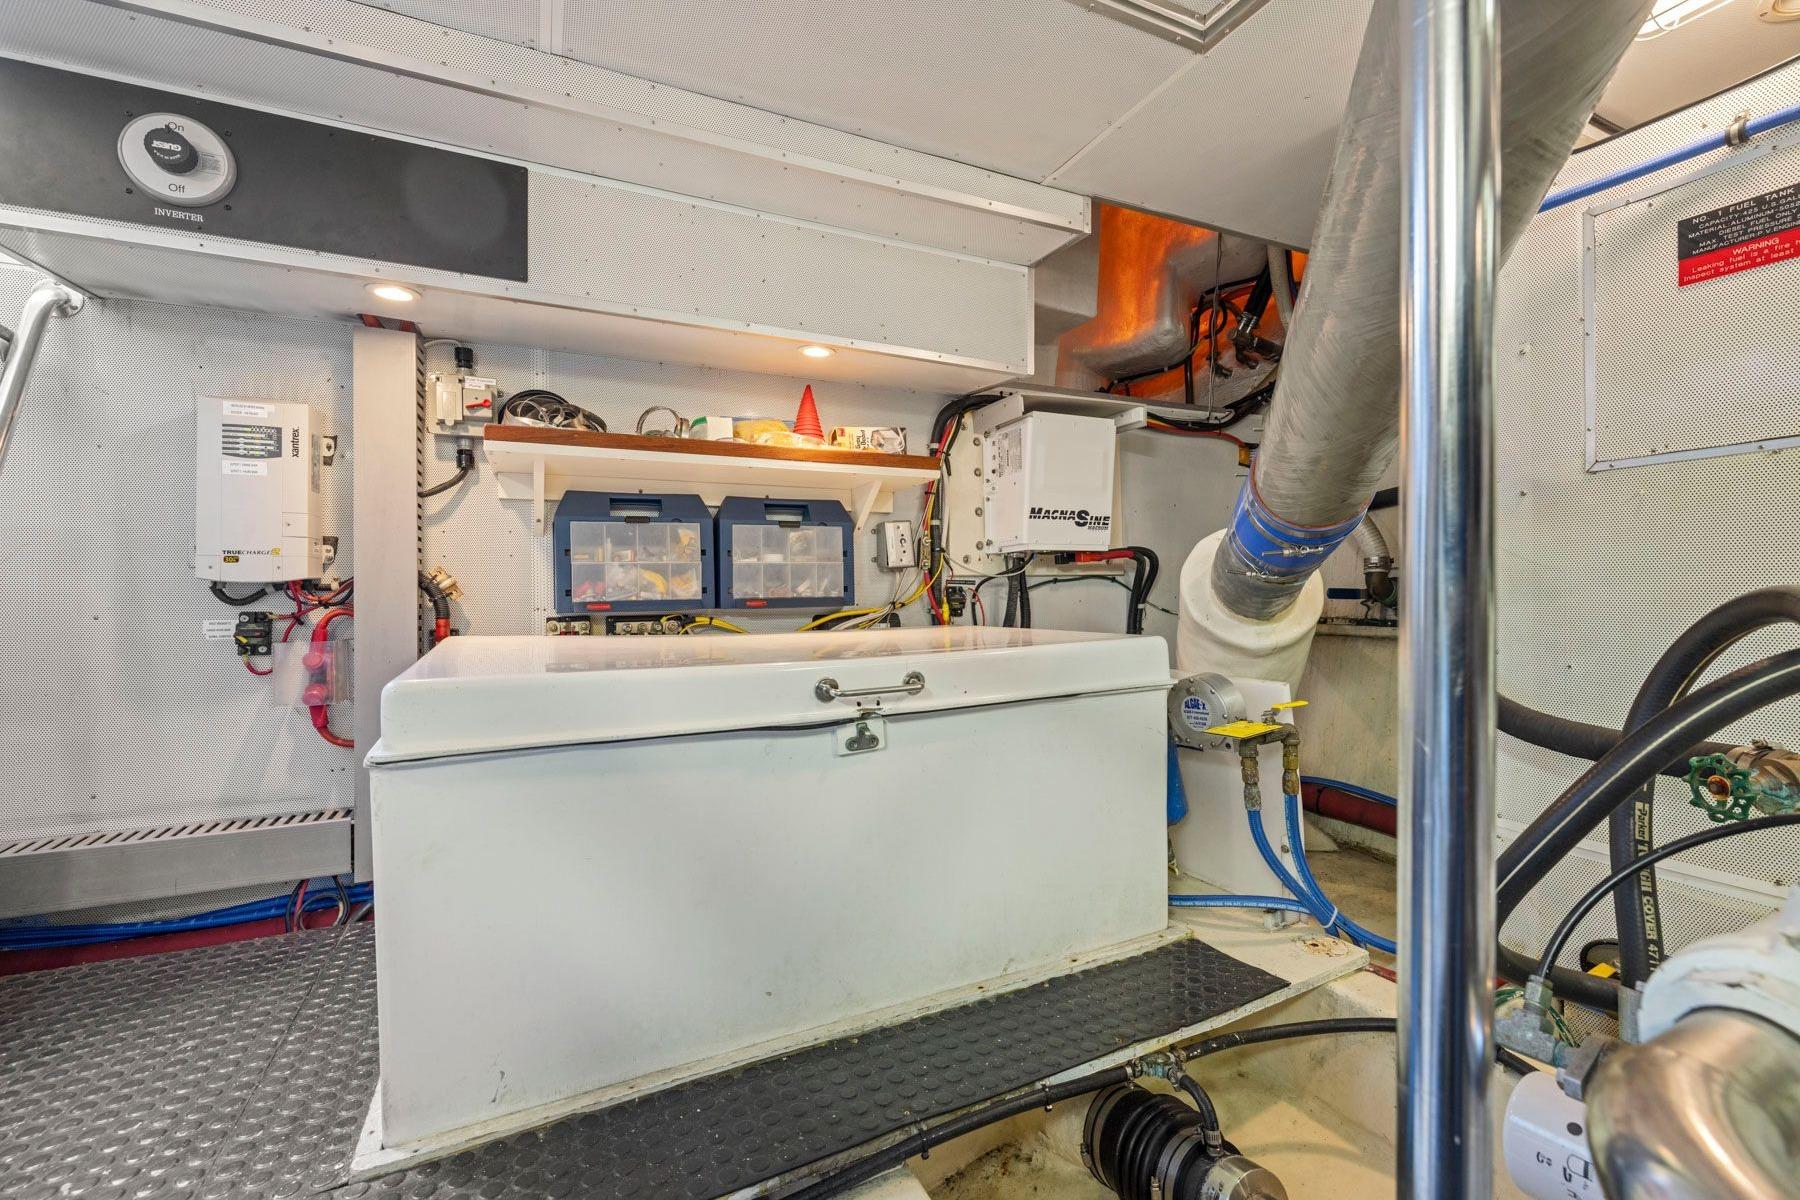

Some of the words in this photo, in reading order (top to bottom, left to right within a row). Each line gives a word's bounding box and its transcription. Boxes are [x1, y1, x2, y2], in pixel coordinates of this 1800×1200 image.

[167, 121, 185, 132] On
[168, 183, 185, 194] Off
[154, 207, 204, 222] INVERTER
[1692, 215, 1710, 225] NO.
[1729, 200, 1757, 213] FUEL
[1764, 187, 1795, 201] TANK
[1718, 224, 1746, 236] DIESEL
[1750, 216, 1770, 226] FUEL
[1775, 208, 1798, 219] ONLY
[1723, 230, 1743, 241] TEST
[1747, 216, 1793, 234] PRESSURE
[1692, 261, 1725, 274] Leaking
[1729, 254, 1746, 263] fuel
[1750, 250, 1759, 258] is
[1774, 242, 1791, 251] fire
[1732, 237, 1780, 256] WARNING
[1683, 268, 1716, 283] Inspect
[1719, 260, 1752, 273] system
[1770, 247, 1795, 260] least
[291, 427, 300, 458] xantrex
[1637, 806, 1649, 842] Parker
[1638, 841, 1653, 892] TGH
[1642, 895, 1657, 940] COVER
